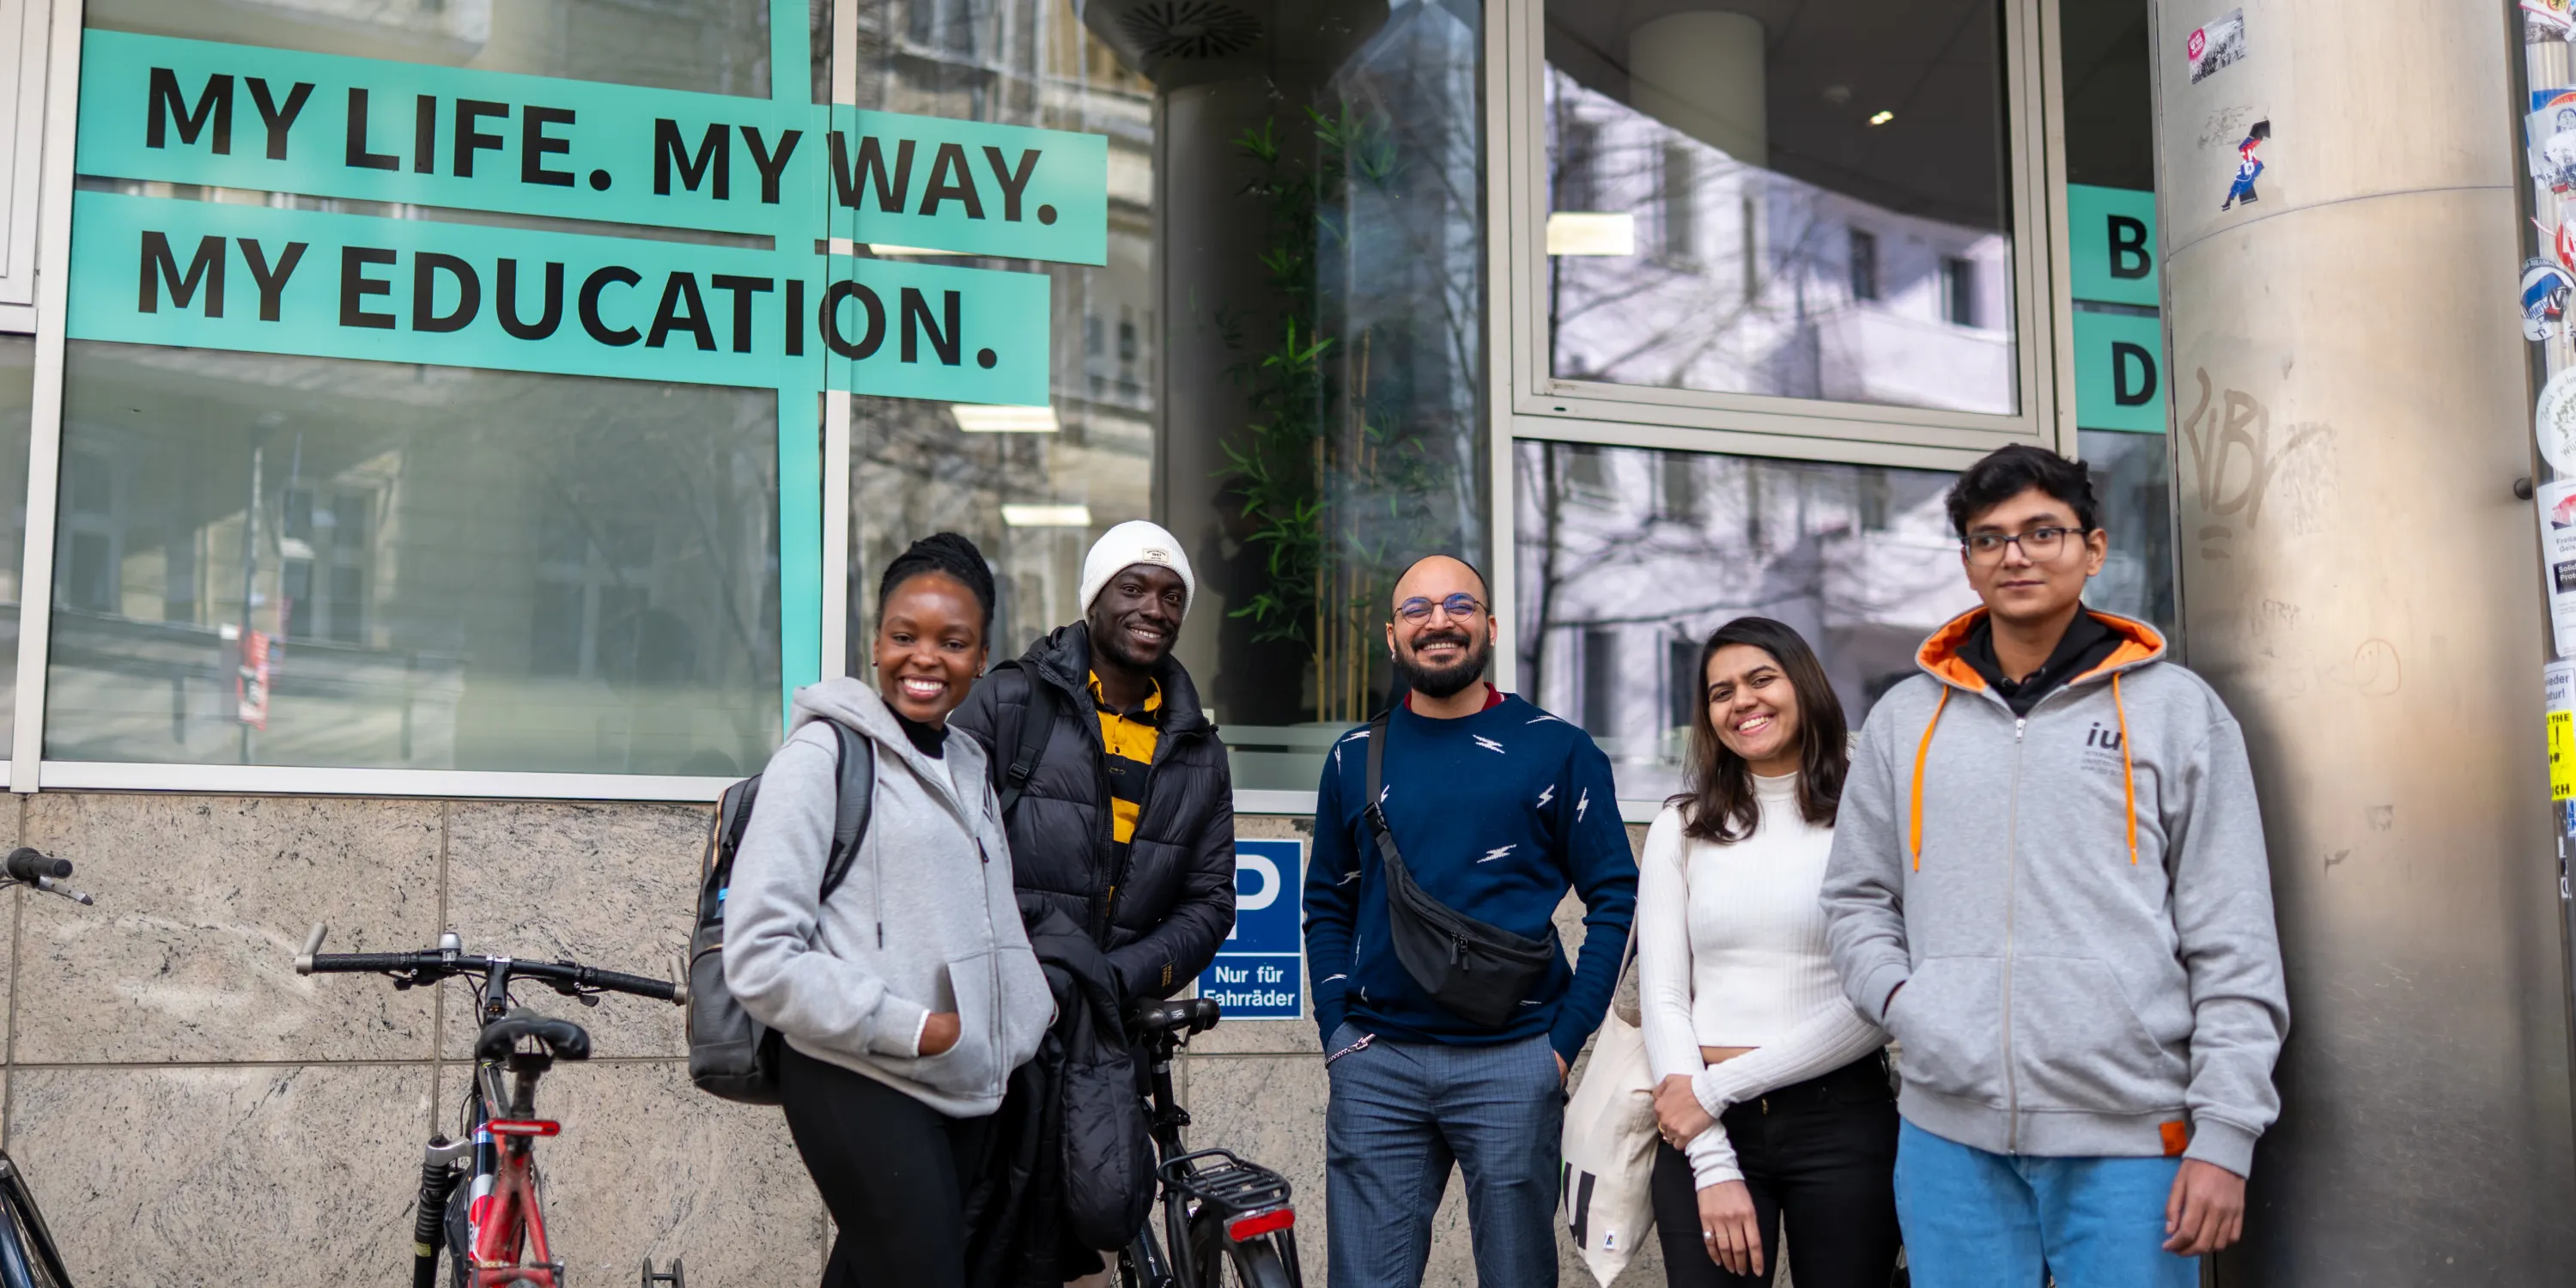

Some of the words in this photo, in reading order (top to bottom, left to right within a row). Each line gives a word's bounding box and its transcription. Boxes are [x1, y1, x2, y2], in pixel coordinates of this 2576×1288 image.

[147, 68, 314, 158] MY
[346, 88, 611, 191] LIFE.
[654, 118, 803, 204] MY
[828, 131, 1059, 226] WAY.
[2107, 214, 2151, 280] B
[139, 232, 307, 321] MY
[340, 246, 998, 369] EDUCATION.
[2111, 341, 2157, 406] D
[2087, 722, 2123, 750] iu
[1226, 854, 1280, 940] P
[1204, 990, 1295, 1006] Fahrräder
[1216, 967, 1249, 983] Nur
[1257, 966, 1284, 983] für
